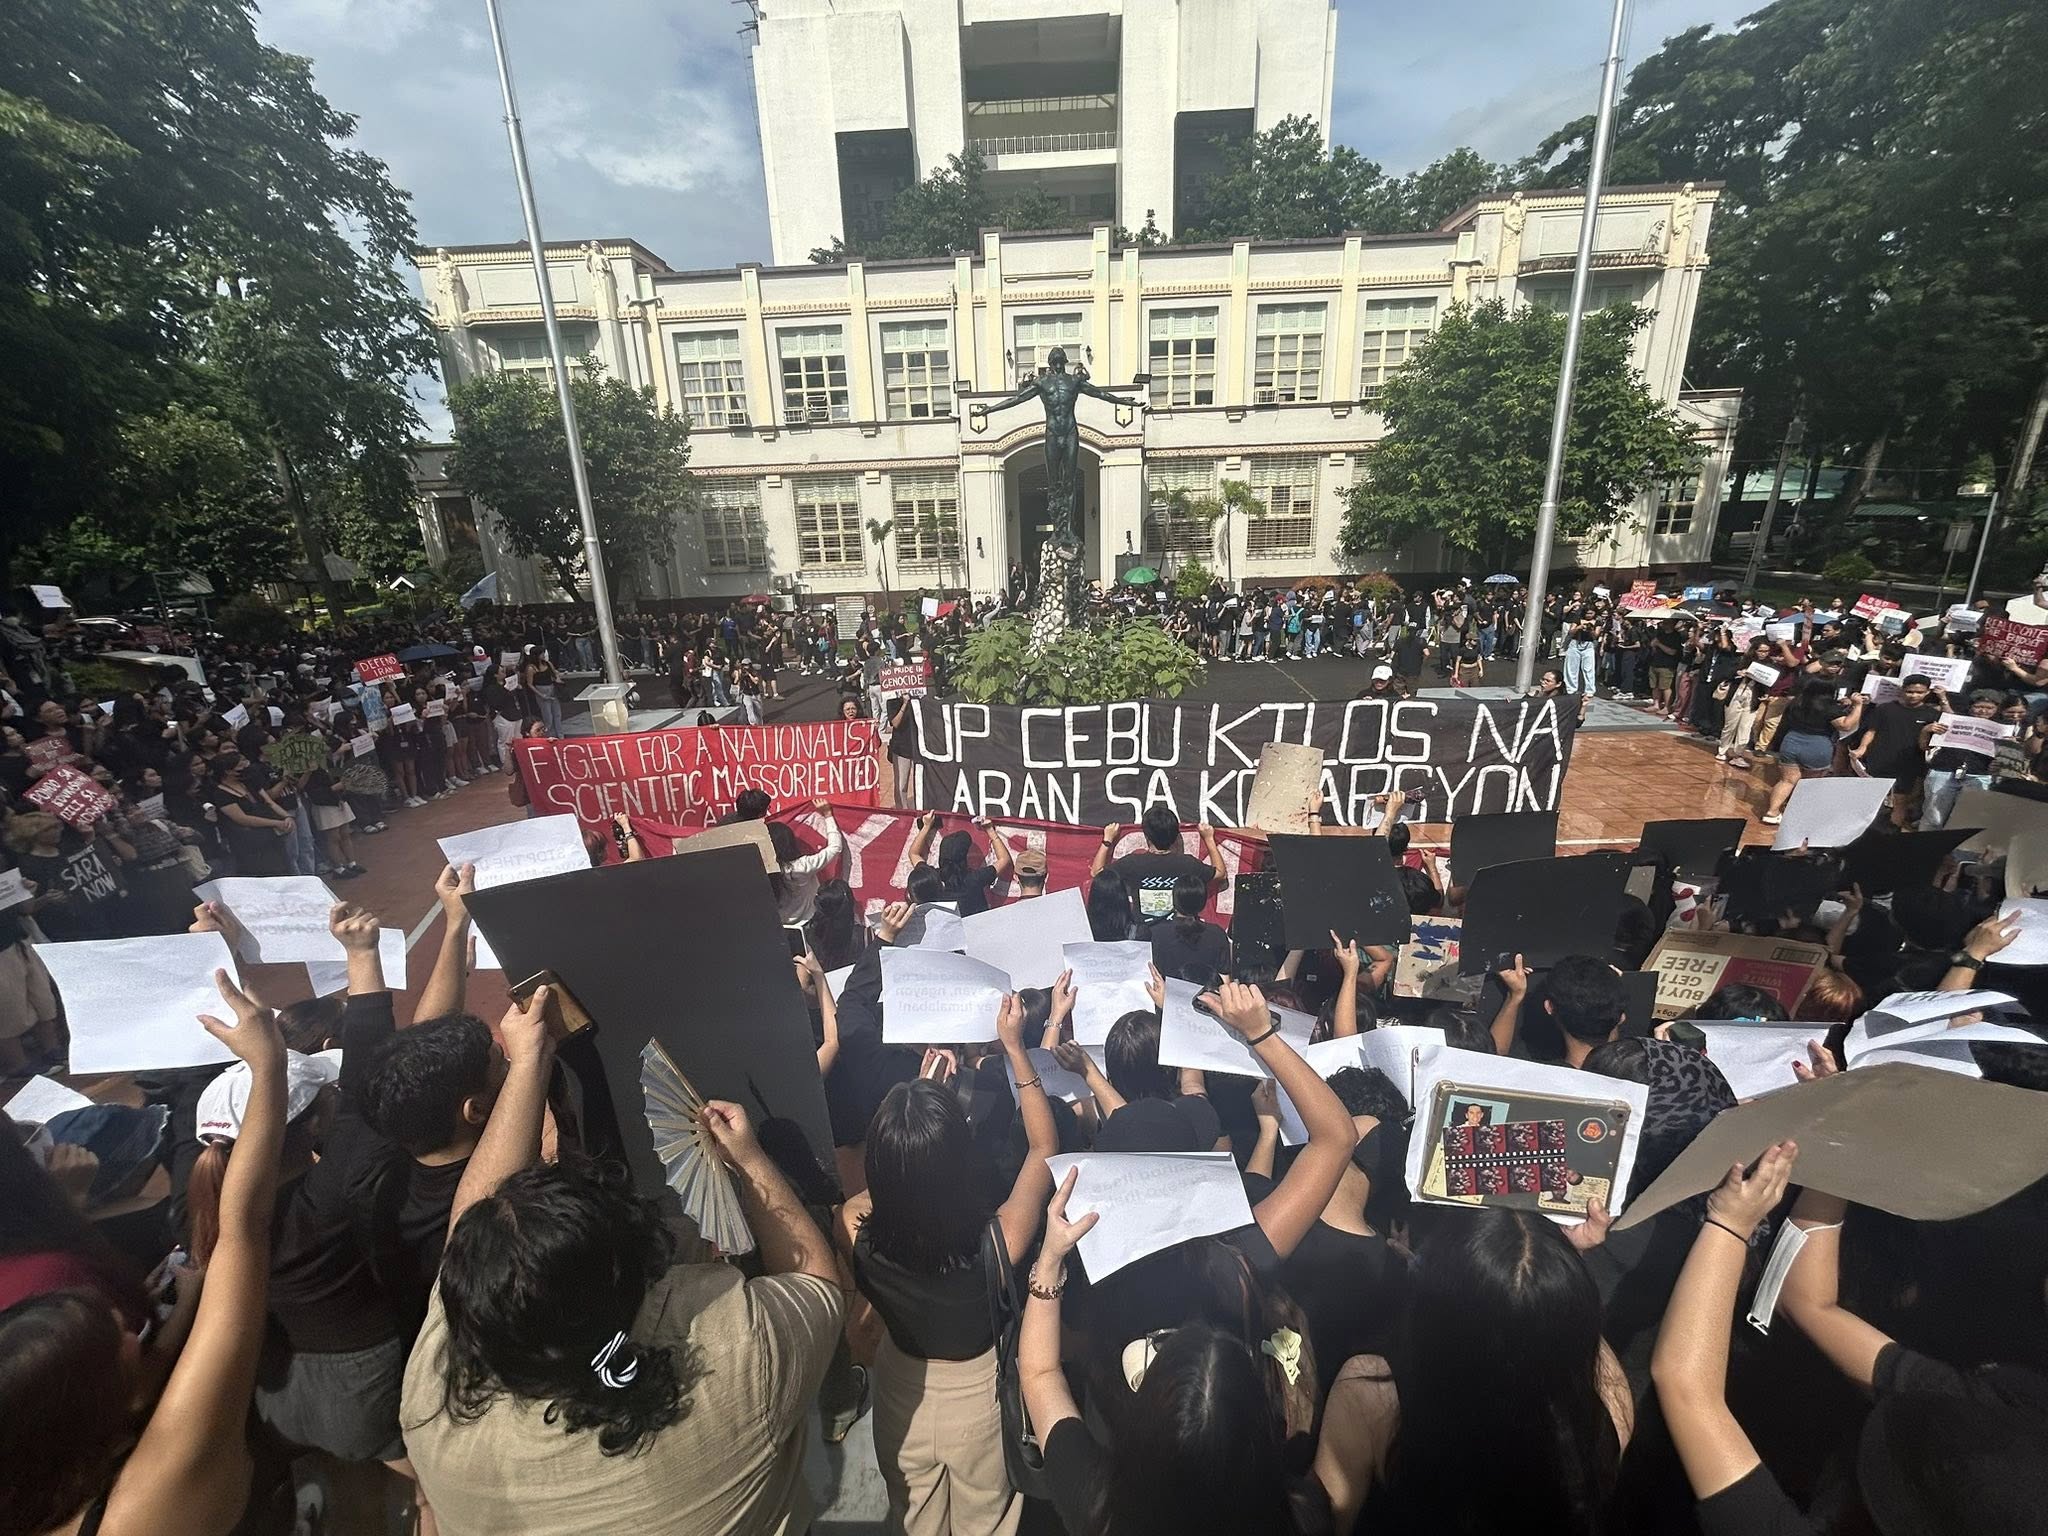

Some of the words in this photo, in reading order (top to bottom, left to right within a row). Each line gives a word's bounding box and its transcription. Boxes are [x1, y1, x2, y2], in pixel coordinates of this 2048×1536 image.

[359, 656, 397, 672] DEFEND
[374, 666, 394, 677] IRAN
[894, 666, 914, 674] PRIDE
[882, 674, 923, 689] GENOCIDE
[911, 699, 990, 763] UP
[1021, 701, 1182, 769] CEBU
[1466, 699, 1563, 764] NA
[527, 738, 627, 785] FIGHT
[637, 733, 684, 773] FOR
[697, 723, 713, 764] A
[719, 719, 879, 762] NATIONALIST,
[57, 768, 75, 781] SA
[1105, 767, 1181, 825] SA
[60, 799, 86, 821] DILI
[80, 789, 98, 802] SA
[60, 852, 107, 891] SARA
[82, 871, 117, 903] NOW
[1662, 956, 1719, 974] FREE
[1672, 974, 1702, 987] GET
[1666, 986, 1705, 1001] BUY
